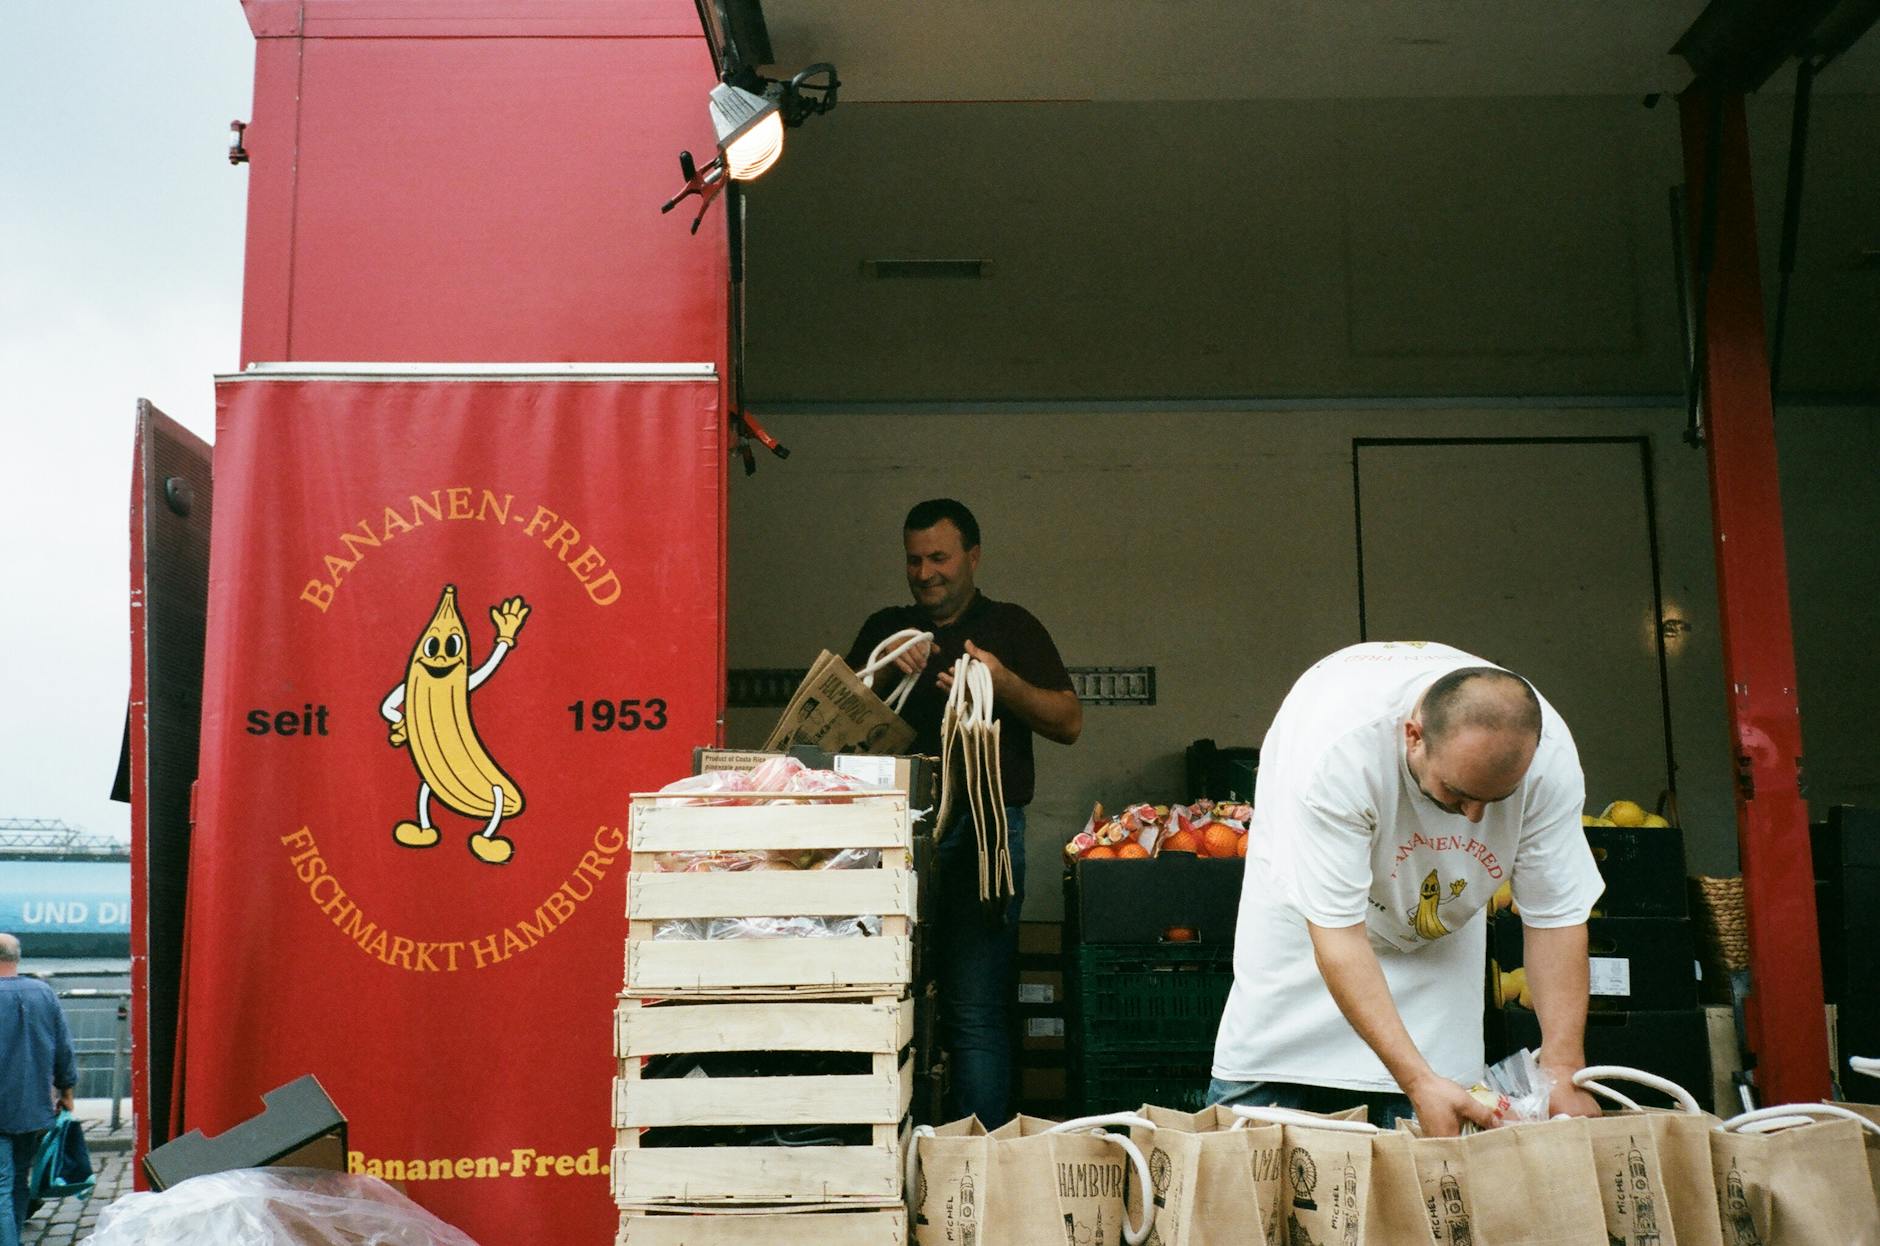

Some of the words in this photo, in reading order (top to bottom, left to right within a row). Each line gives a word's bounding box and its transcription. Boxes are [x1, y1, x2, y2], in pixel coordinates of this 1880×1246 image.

[300, 487, 622, 614] BANANEN-FRED
[246, 703, 329, 737] seit
[568, 698, 668, 732] 1953
[22, 901, 88, 925] UND
[281, 825, 464, 972] FISCHMARKT
[472, 824, 625, 970] HAMBURG
